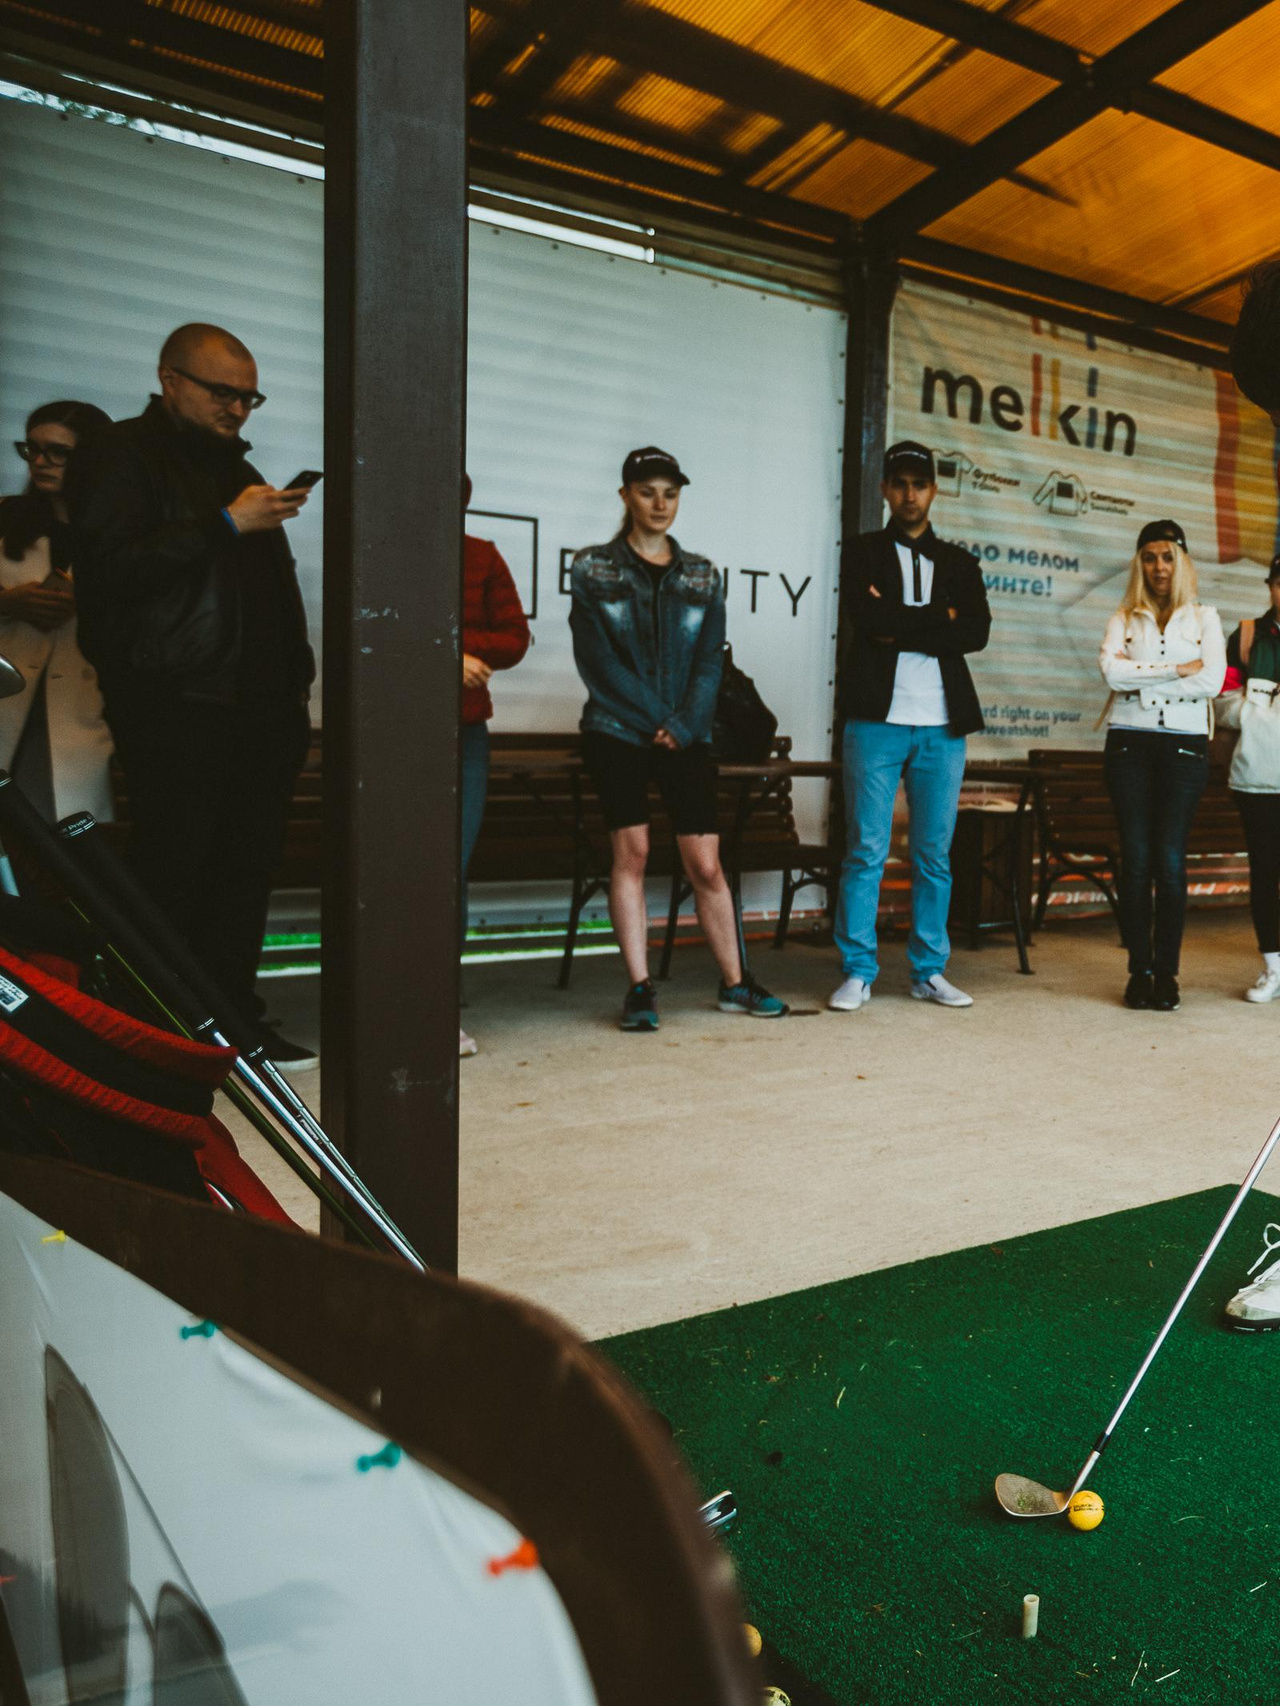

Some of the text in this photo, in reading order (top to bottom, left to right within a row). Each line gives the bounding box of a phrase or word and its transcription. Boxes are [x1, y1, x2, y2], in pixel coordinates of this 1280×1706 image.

[921, 354, 1137, 456] melkin
[1008, 547, 1079, 573] мелом
[985, 574, 1054, 598] инте!
[1052, 711, 1082, 725] your
